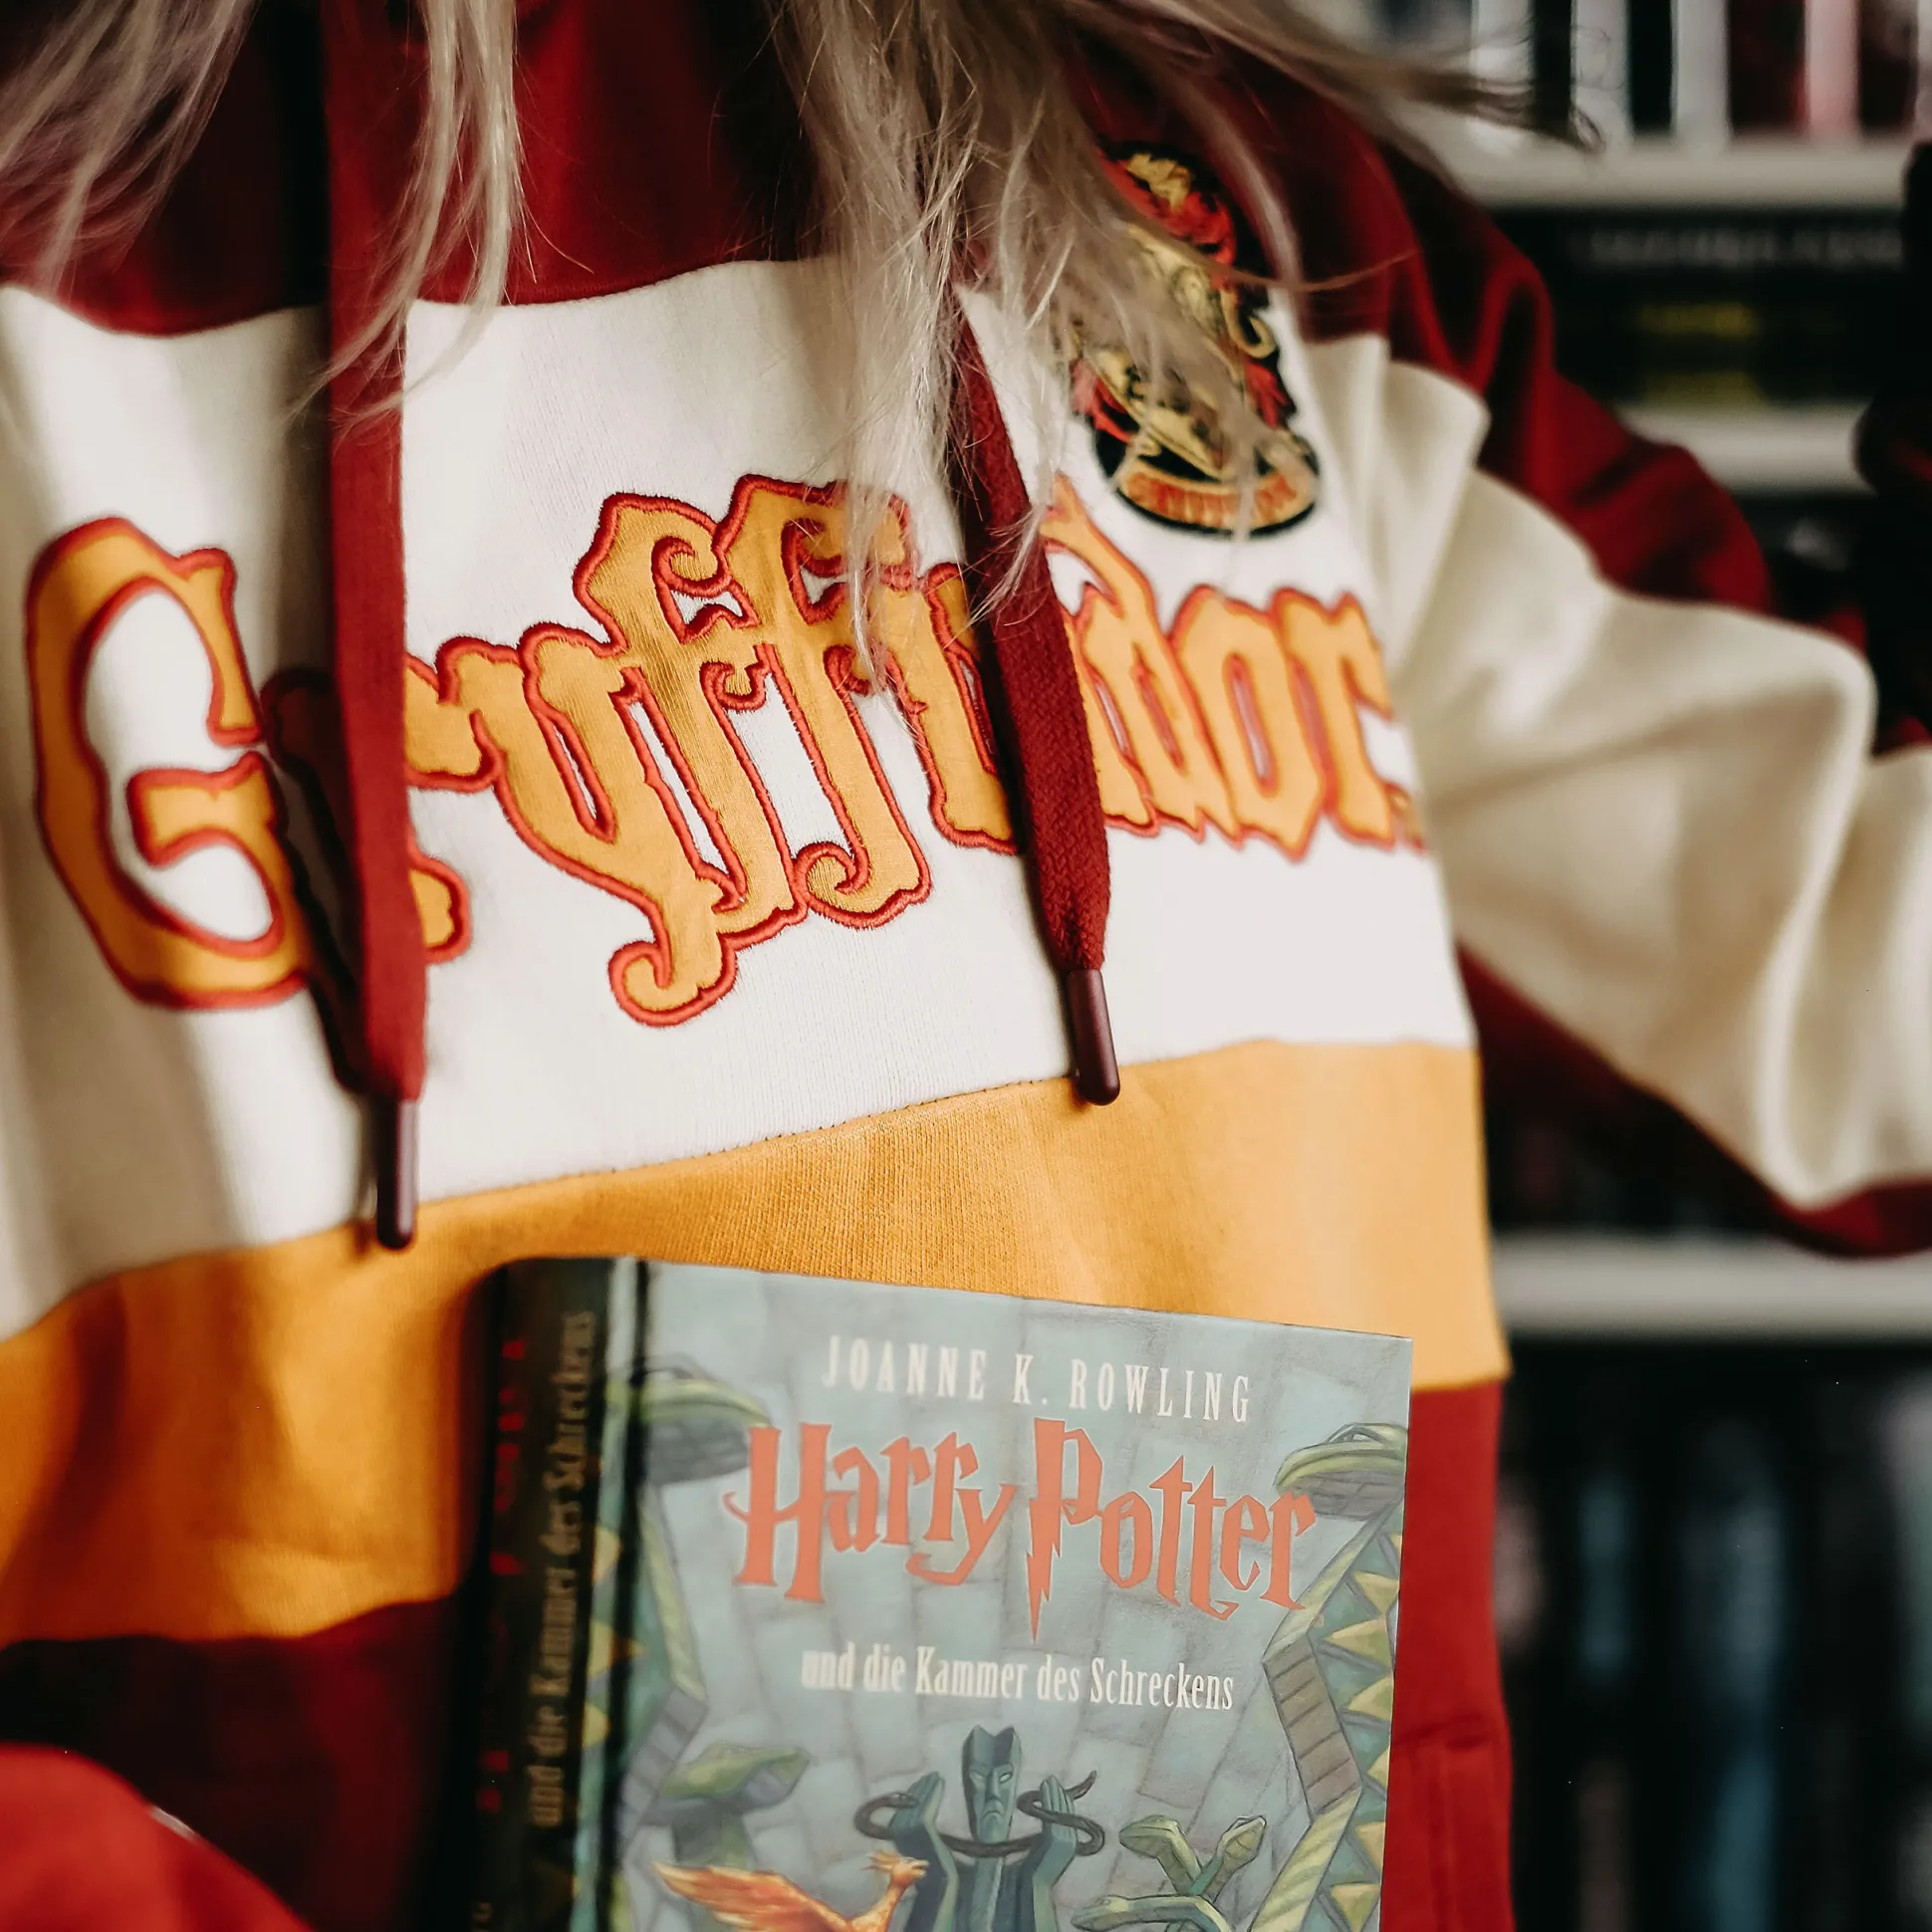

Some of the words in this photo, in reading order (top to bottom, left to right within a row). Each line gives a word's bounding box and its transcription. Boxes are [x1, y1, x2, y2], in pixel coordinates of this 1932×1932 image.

[822, 1334, 987, 1400] JOANNE
[1012, 1352, 1049, 1405] K.
[1069, 1358, 1250, 1423] ROWLING
[722, 1421, 1017, 1602] Harry
[1026, 1417, 1317, 1643] Potter
[801, 1641, 856, 1692] und
[863, 1643, 906, 1694] die
[915, 1645, 1028, 1700] Kammer
[1036, 1654, 1081, 1702] des
[1088, 1656, 1235, 1711] Schreckens
